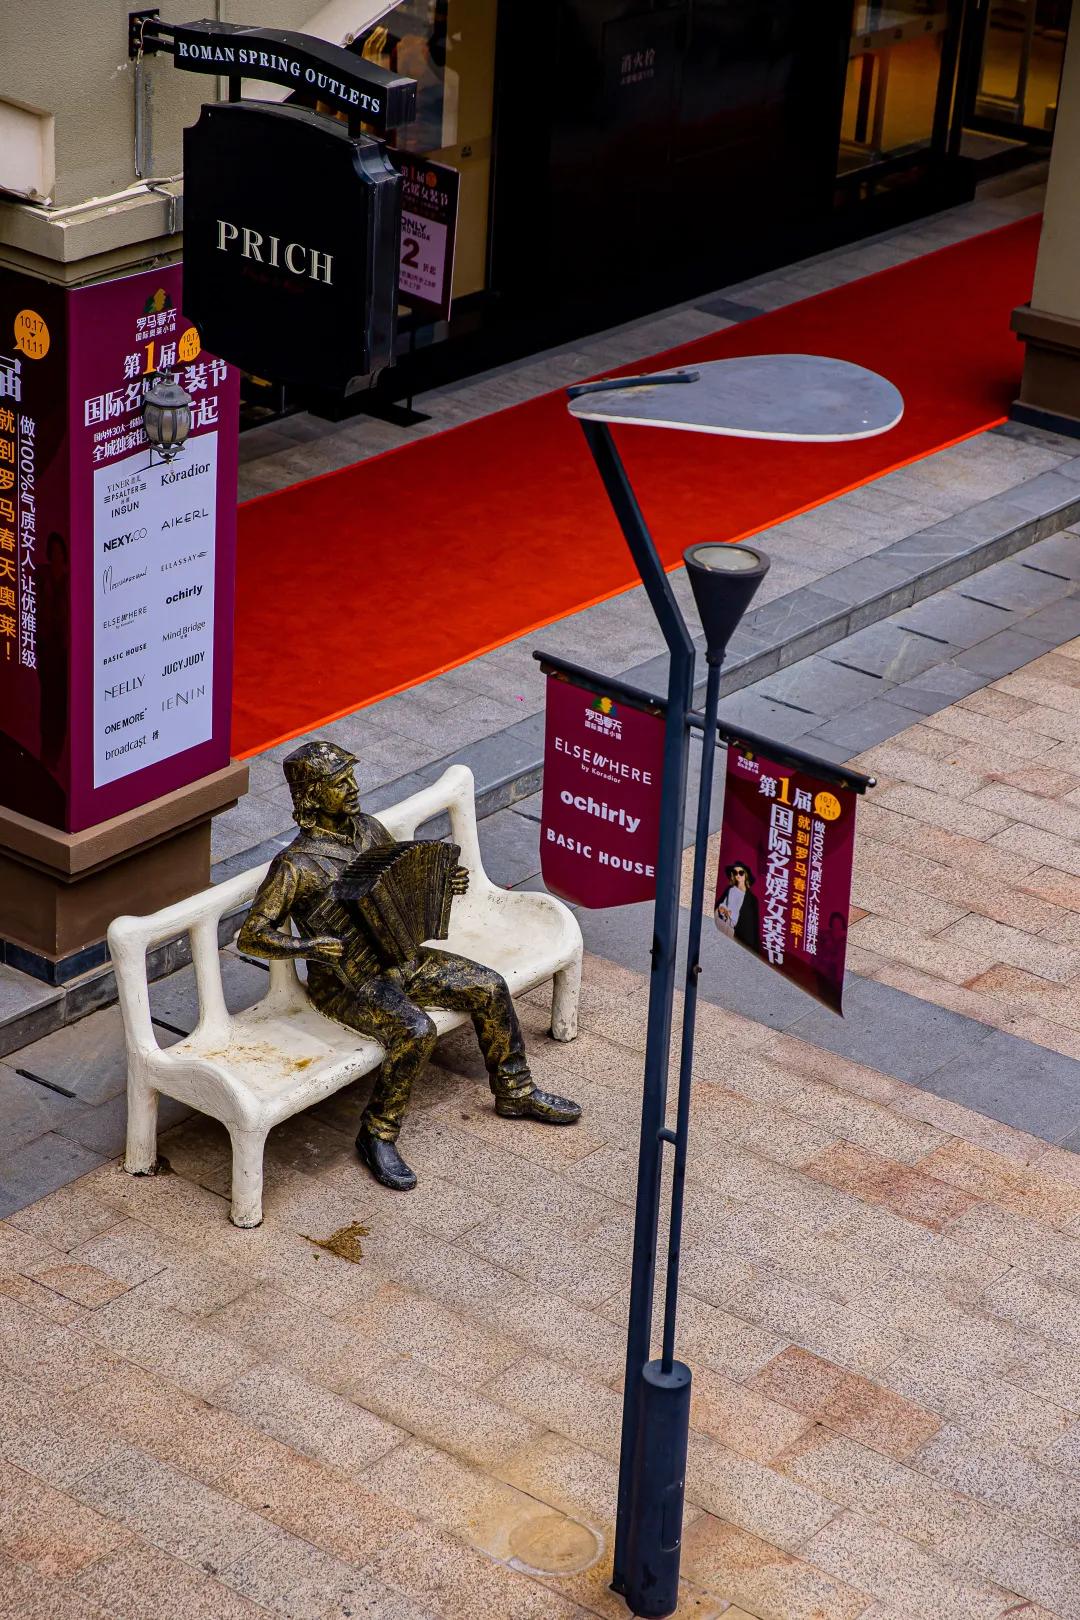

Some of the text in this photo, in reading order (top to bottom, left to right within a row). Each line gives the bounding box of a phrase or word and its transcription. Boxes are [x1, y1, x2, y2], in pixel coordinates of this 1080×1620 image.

[179, 42, 380, 113] ROMAN SPRING OUTLETS
[216, 220, 334, 286] PRICH
[401, 238, 419, 269] 2
[20, 315, 44, 333] 10.17
[136, 308, 177, 331] 罗马春天
[20, 337, 43, 354] 11.11
[123, 341, 177, 380] 第1届
[111, 485, 139, 501] PSALTER
[111, 501, 140, 518] INSUN
[161, 508, 209, 531] AIKERL
[103, 527, 148, 553] NEXY.CO
[160, 553, 197, 572] ELLASSAY
[165, 585, 203, 604] ochirly
[103, 606, 147, 629] ELSEWHERE
[161, 628, 181, 641] Mind
[182, 621, 205, 635] Bridge
[103, 643, 147, 665] BASIC HOUSE
[104, 674, 145, 702] NEELLY
[104, 721, 121, 735] ONE
[105, 735, 146, 760] broadcast
[555, 736, 652, 785] ELSEWHERE
[581, 763, 622, 784] by Koradior
[758, 774, 813, 812] 第1届
[560, 790, 640, 833] ochirly
[546, 828, 655, 877] BASIC HOUSE
[762, 803, 794, 965] 国际名媛女装节
